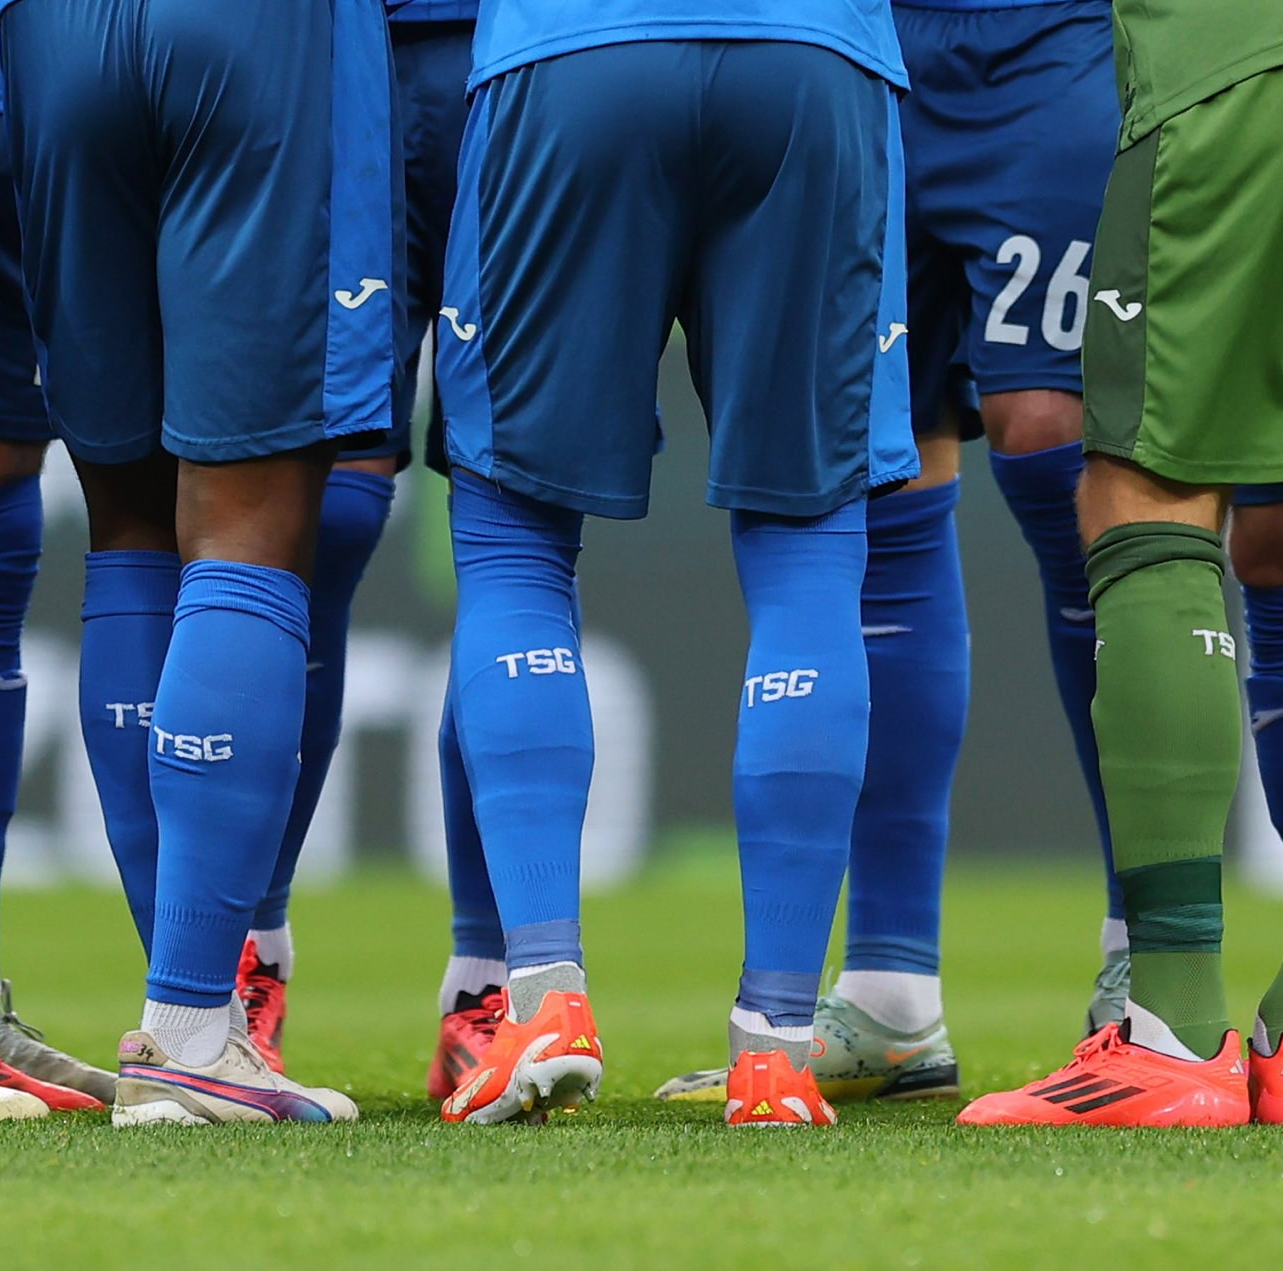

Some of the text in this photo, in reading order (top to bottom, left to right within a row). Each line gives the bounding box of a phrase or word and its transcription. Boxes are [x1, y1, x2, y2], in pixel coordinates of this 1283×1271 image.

[985, 234, 1091, 352] 26
[1192, 629, 1236, 660] TS
[496, 647, 576, 678] TSG
[745, 668, 818, 708] TSG
[105, 702, 155, 729] TS
[153, 725, 234, 762] TSG
